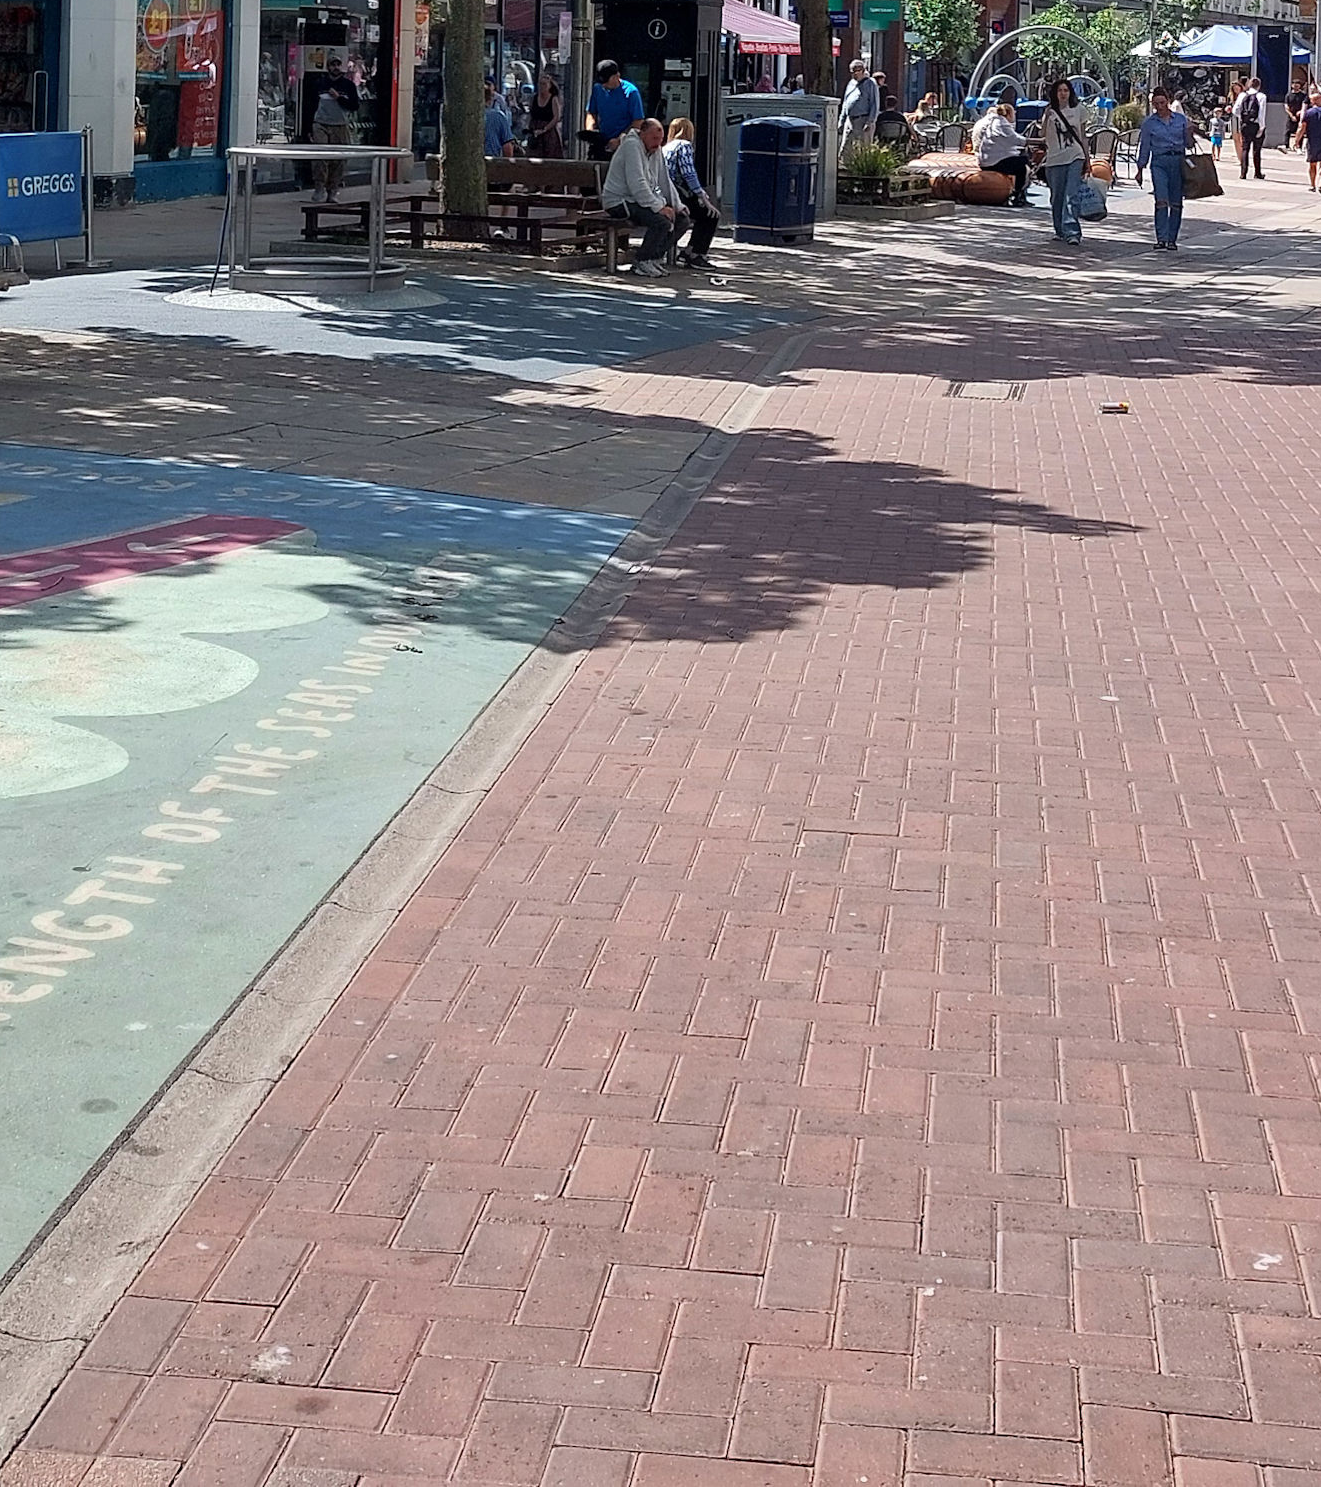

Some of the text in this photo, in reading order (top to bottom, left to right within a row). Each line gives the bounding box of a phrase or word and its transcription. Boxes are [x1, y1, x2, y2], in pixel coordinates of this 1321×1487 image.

[21, 173, 75, 196] GREGGS
[141, 800, 233, 844] OF
[189, 742, 319, 796] THE
[256, 678, 373, 739] SEAS
[322, 650, 391, 677] IN
